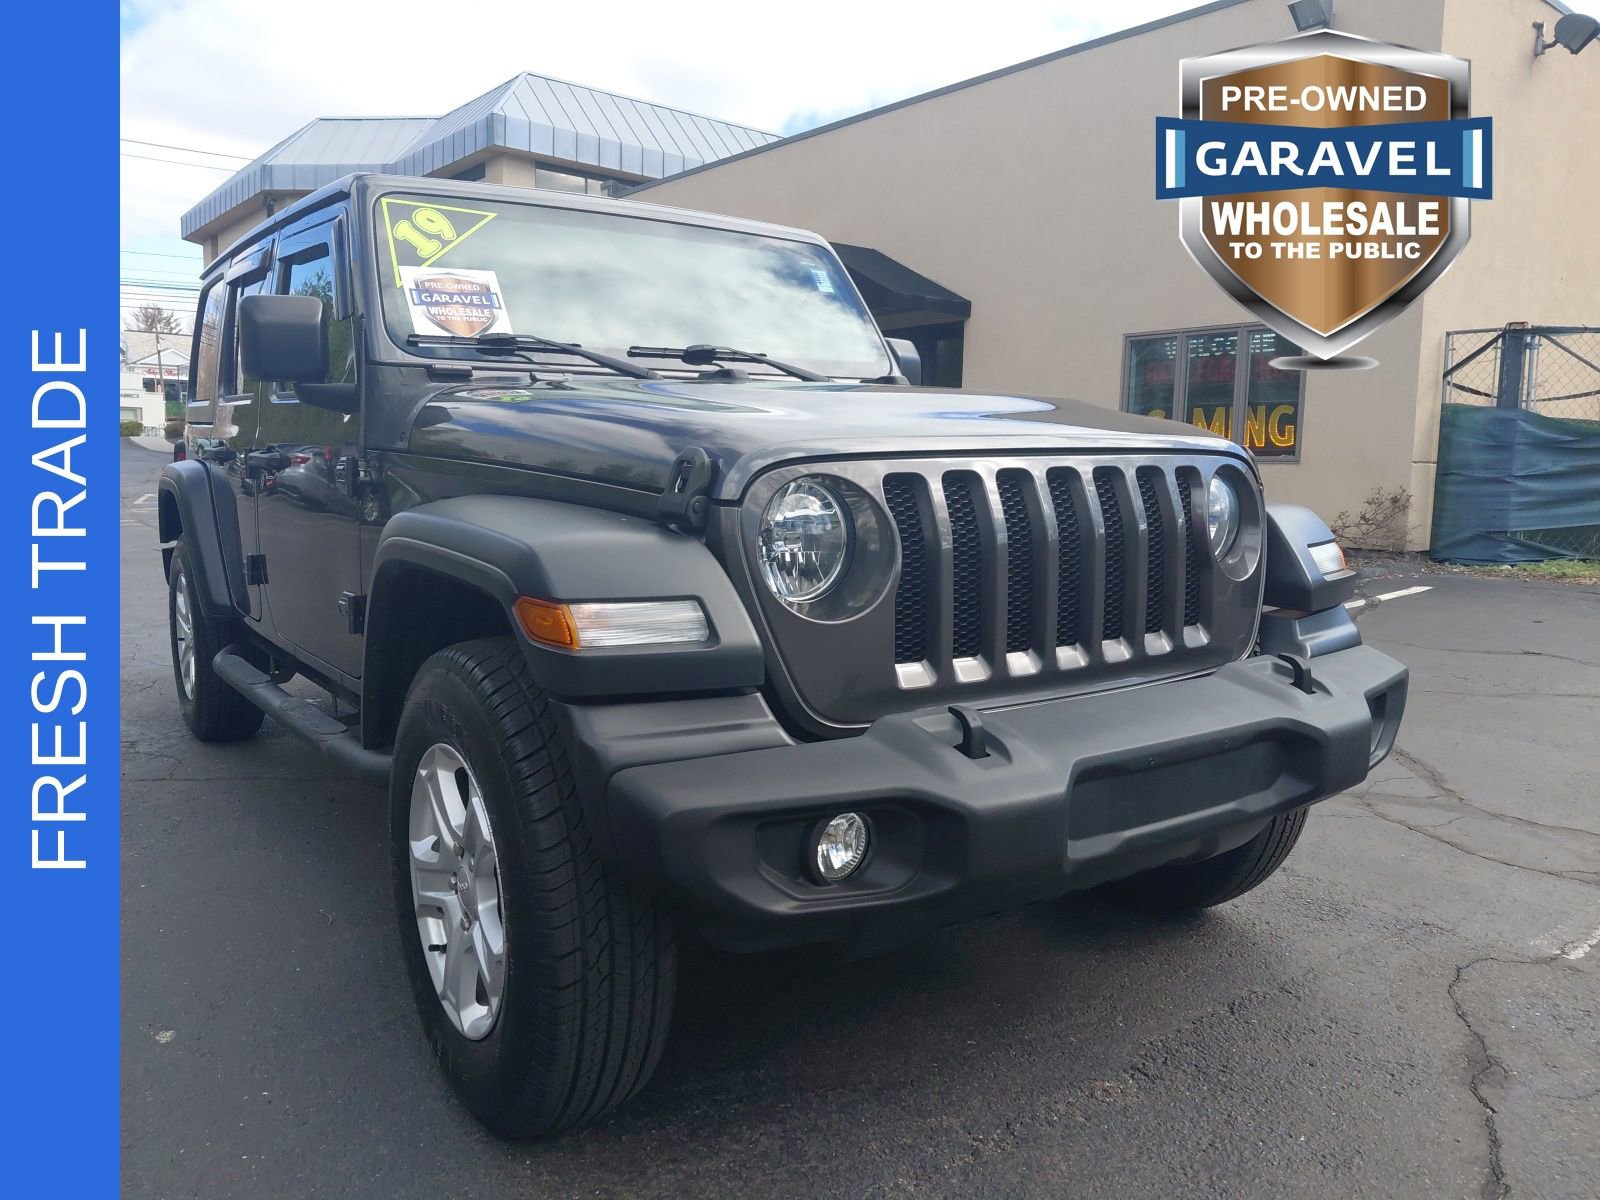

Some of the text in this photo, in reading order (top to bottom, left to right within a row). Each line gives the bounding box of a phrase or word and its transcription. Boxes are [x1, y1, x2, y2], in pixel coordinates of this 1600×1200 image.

[394, 207, 457, 259] 19
[424, 281, 480, 291] PRE-OWNED
[421, 293, 491, 305] GARAVEL
[428, 306, 491, 317] WHOLESALE
